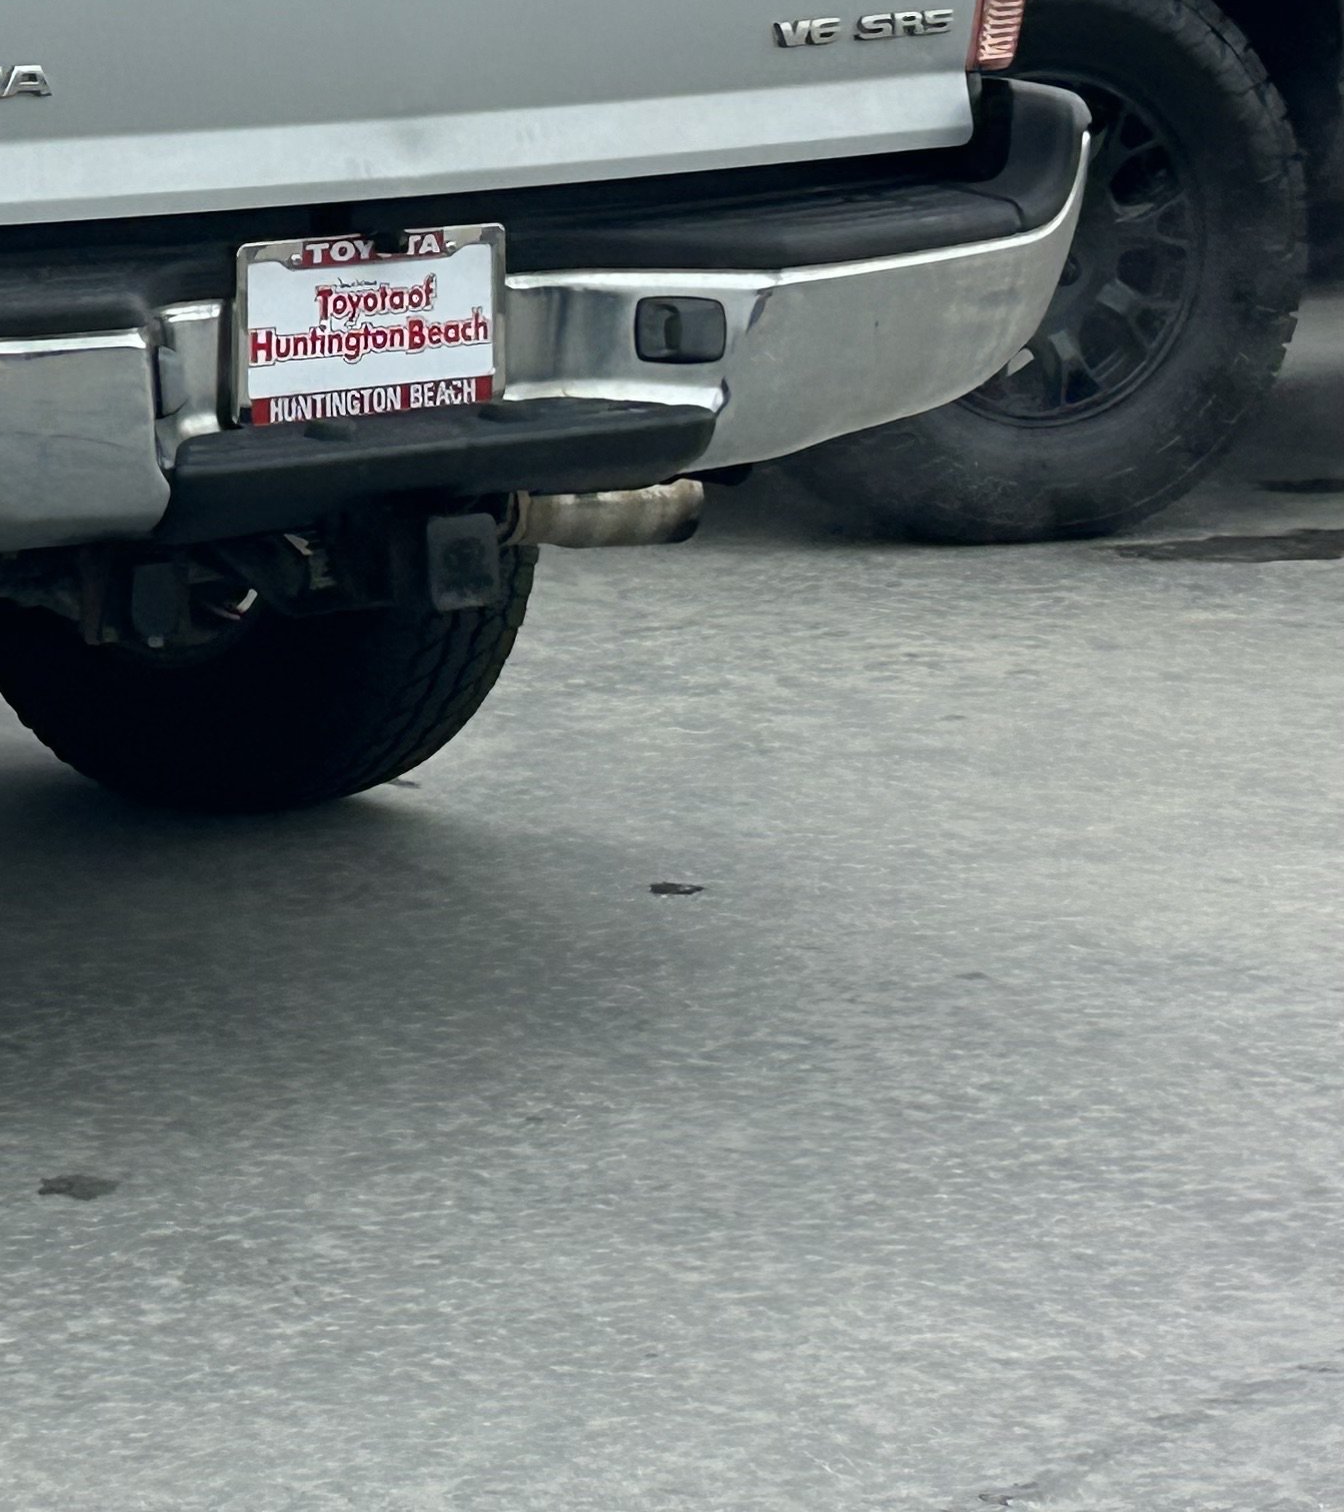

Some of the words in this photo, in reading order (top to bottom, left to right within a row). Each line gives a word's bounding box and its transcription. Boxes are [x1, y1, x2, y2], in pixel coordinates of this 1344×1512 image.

[304, 233, 440, 265] TOYTA
[315, 286, 405, 323] Toyota
[408, 273, 436, 309] of
[250, 322, 404, 364] Huntington
[406, 312, 490, 351] Beach
[269, 385, 402, 423] HUNTINGTON
[410, 378, 476, 409] BEACH
